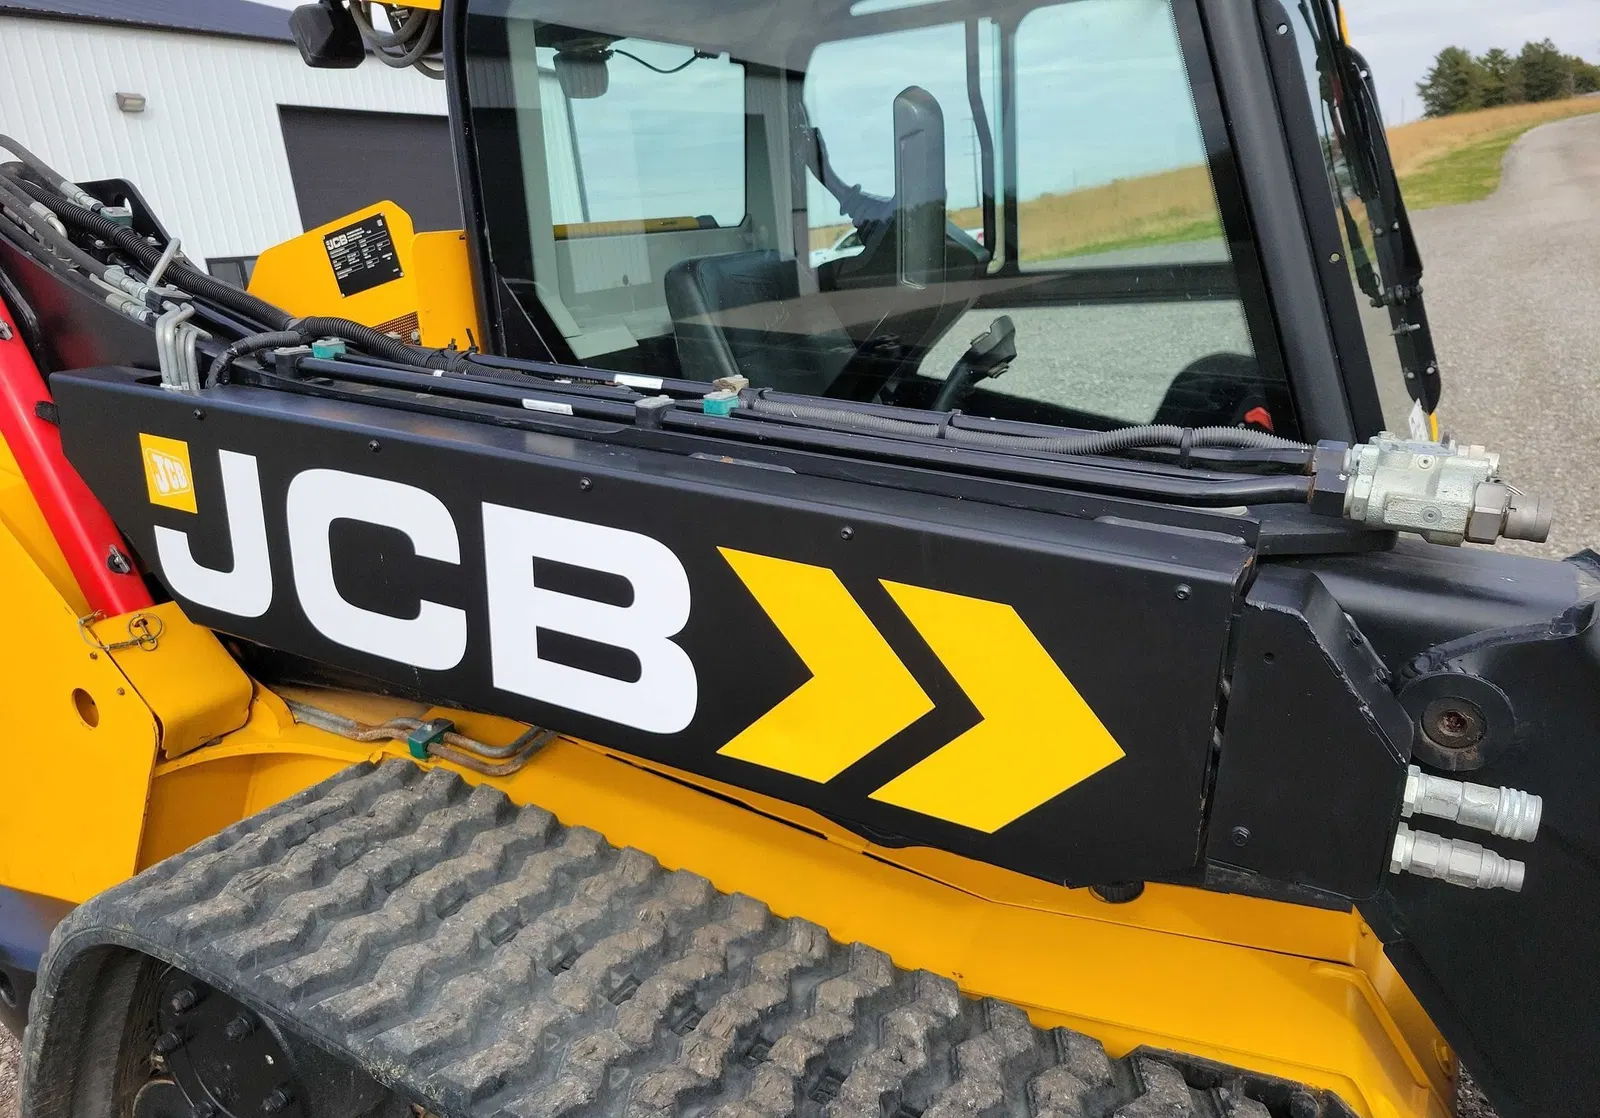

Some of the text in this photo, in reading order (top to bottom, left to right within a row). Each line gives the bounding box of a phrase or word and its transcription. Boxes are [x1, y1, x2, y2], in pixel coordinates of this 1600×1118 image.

[326, 234, 348, 250] JCB
[151, 453, 188, 493] JCB
[153, 449, 699, 735] JCB
